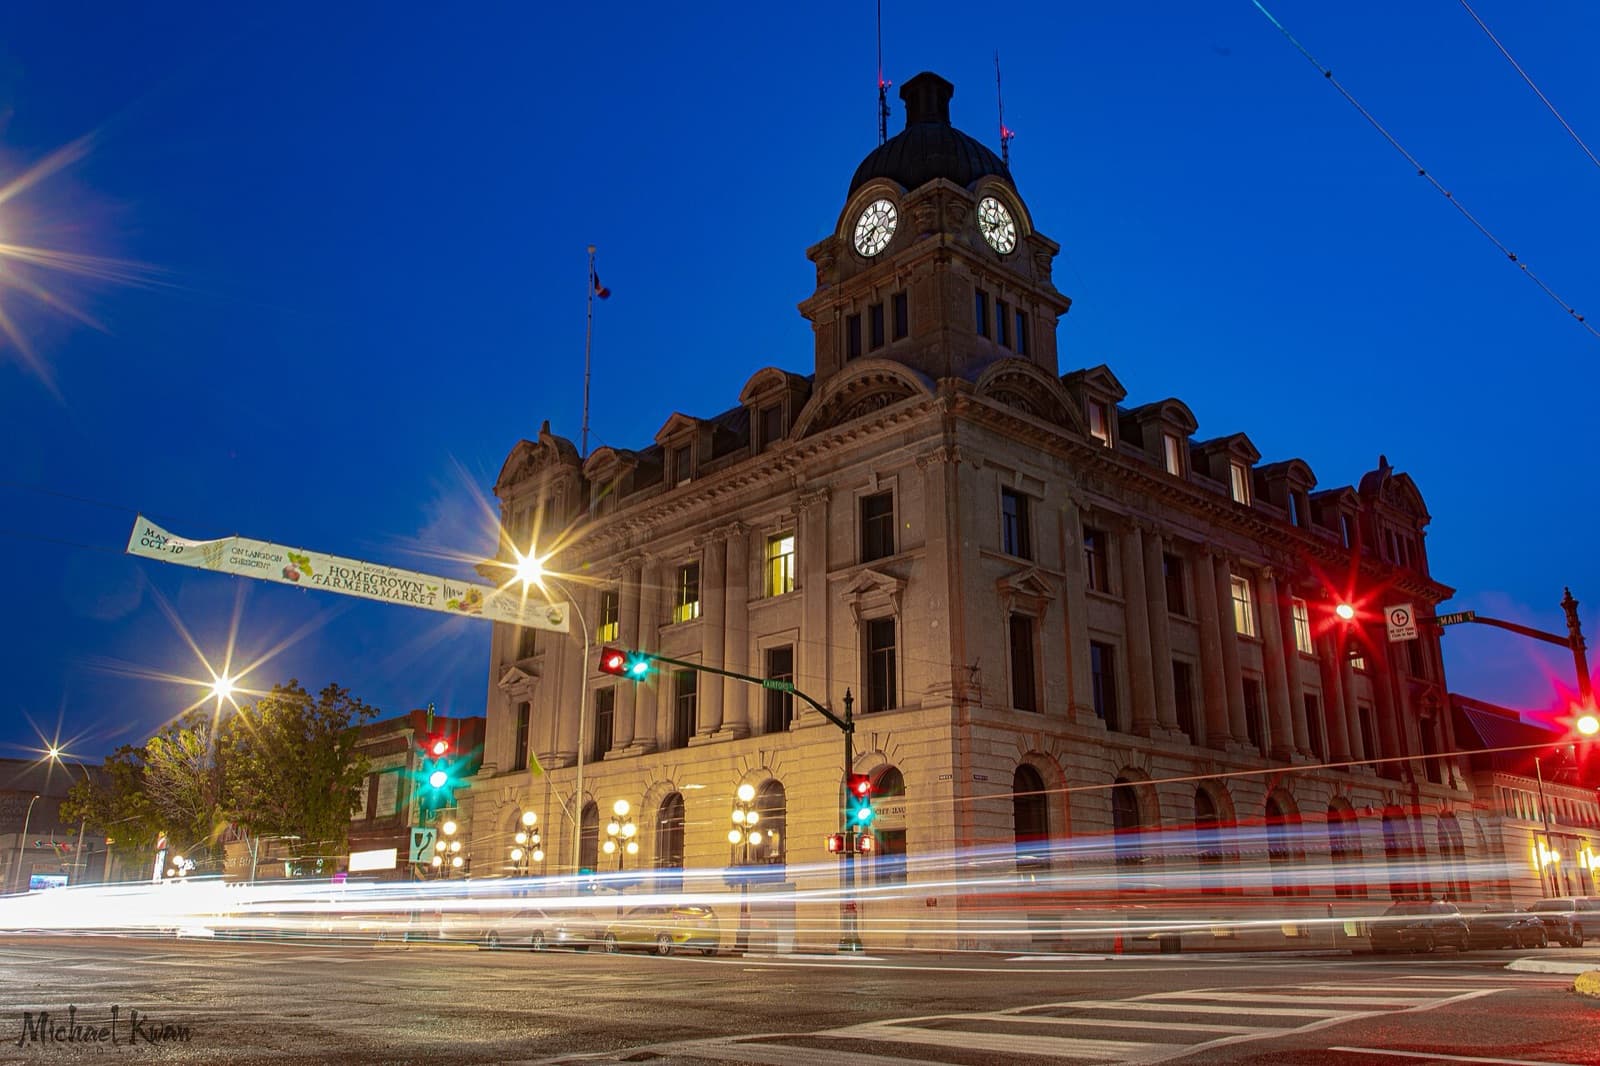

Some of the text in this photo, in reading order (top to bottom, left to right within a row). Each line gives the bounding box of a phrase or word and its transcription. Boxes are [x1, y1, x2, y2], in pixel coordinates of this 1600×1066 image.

[144, 528, 169, 545] MAY
[141, 537, 166, 551] OCT.
[170, 545, 184, 554] 10
[329, 565, 425, 594] HOMEGROWN
[312, 573, 379, 595] FARMERS
[380, 587, 437, 606] MARKET
[1440, 613, 1463, 626] MAIN
